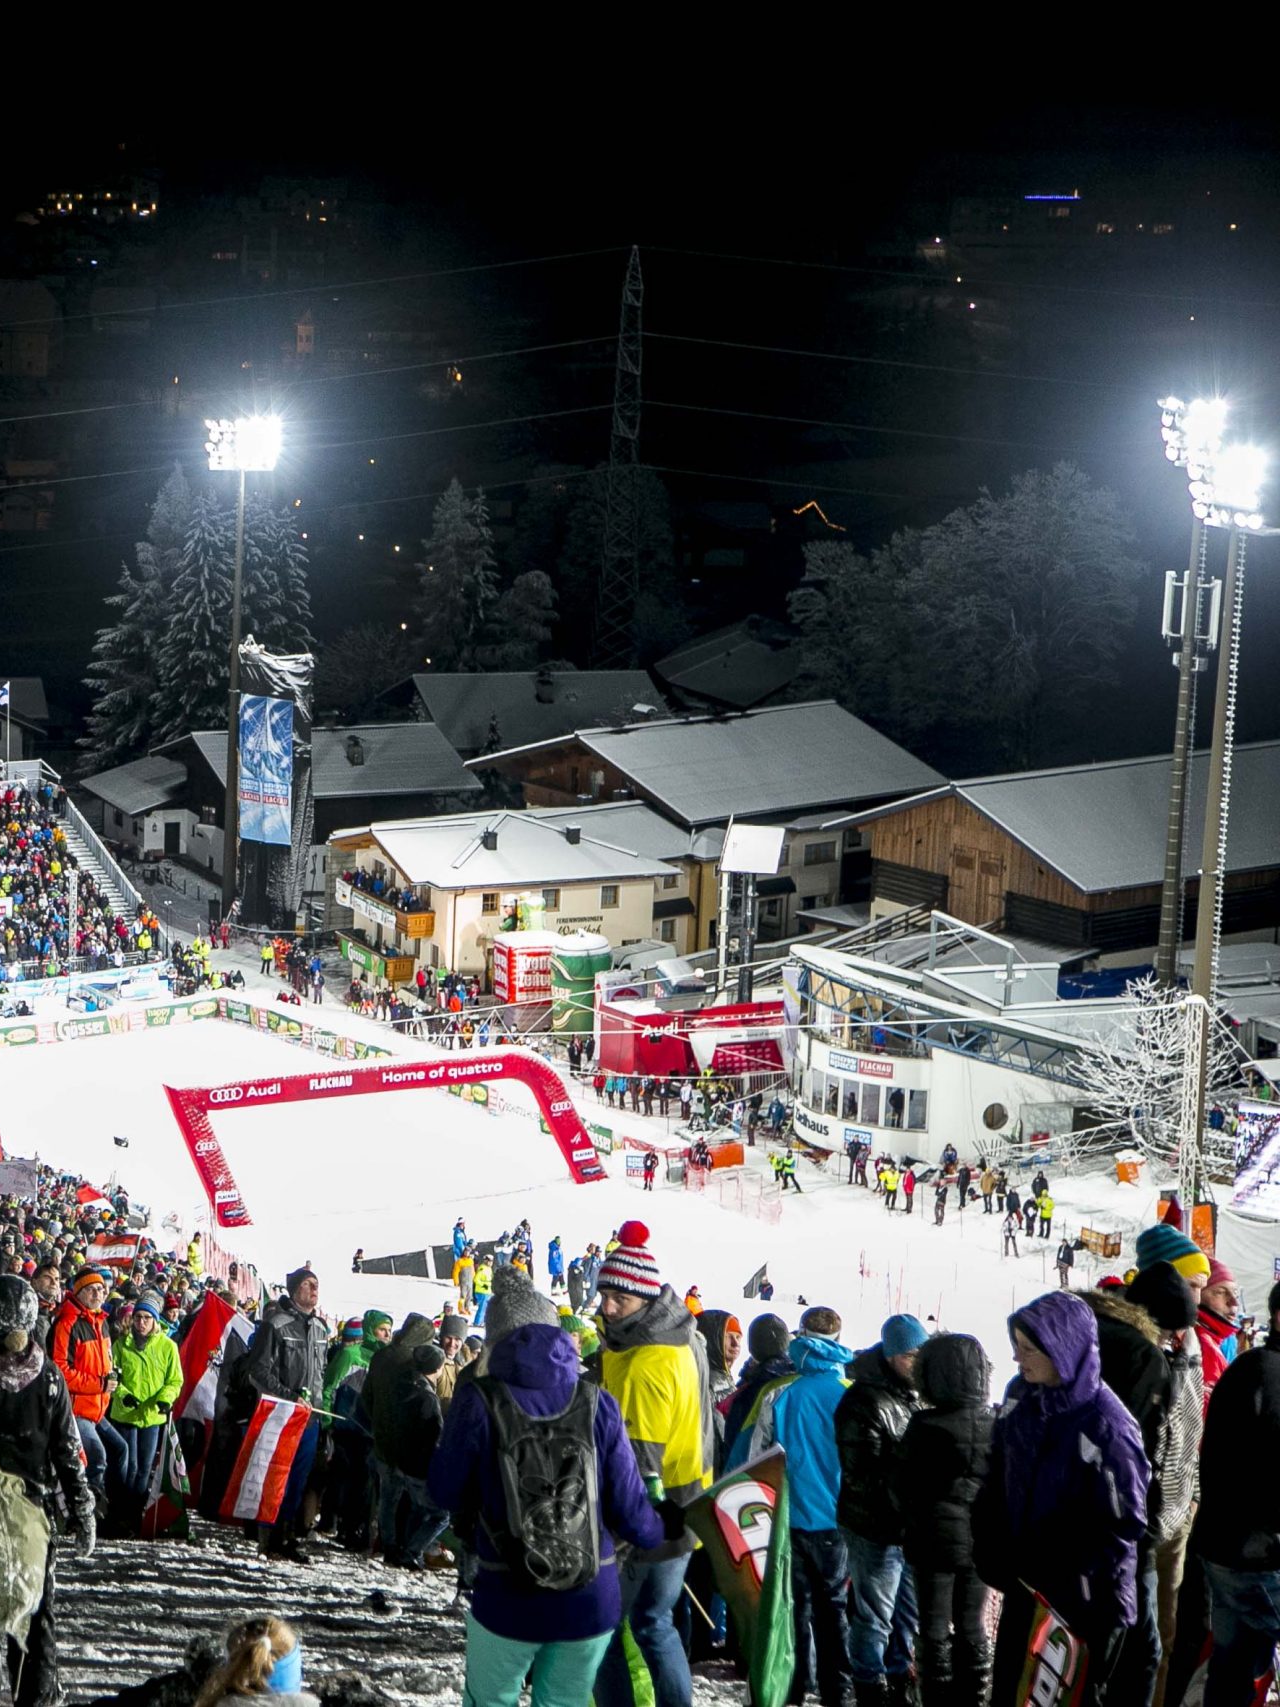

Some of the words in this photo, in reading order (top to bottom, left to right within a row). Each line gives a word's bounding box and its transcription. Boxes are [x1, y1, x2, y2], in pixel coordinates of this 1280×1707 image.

[641, 1017, 678, 1038] Audi
[382, 1071, 425, 1083] Home
[428, 1066, 445, 1079] of
[448, 1062, 503, 1079] quattro
[860, 1061, 891, 1073] FLACHAU
[246, 1083, 281, 1098] Audi
[309, 1075, 353, 1091] FLACHAU
